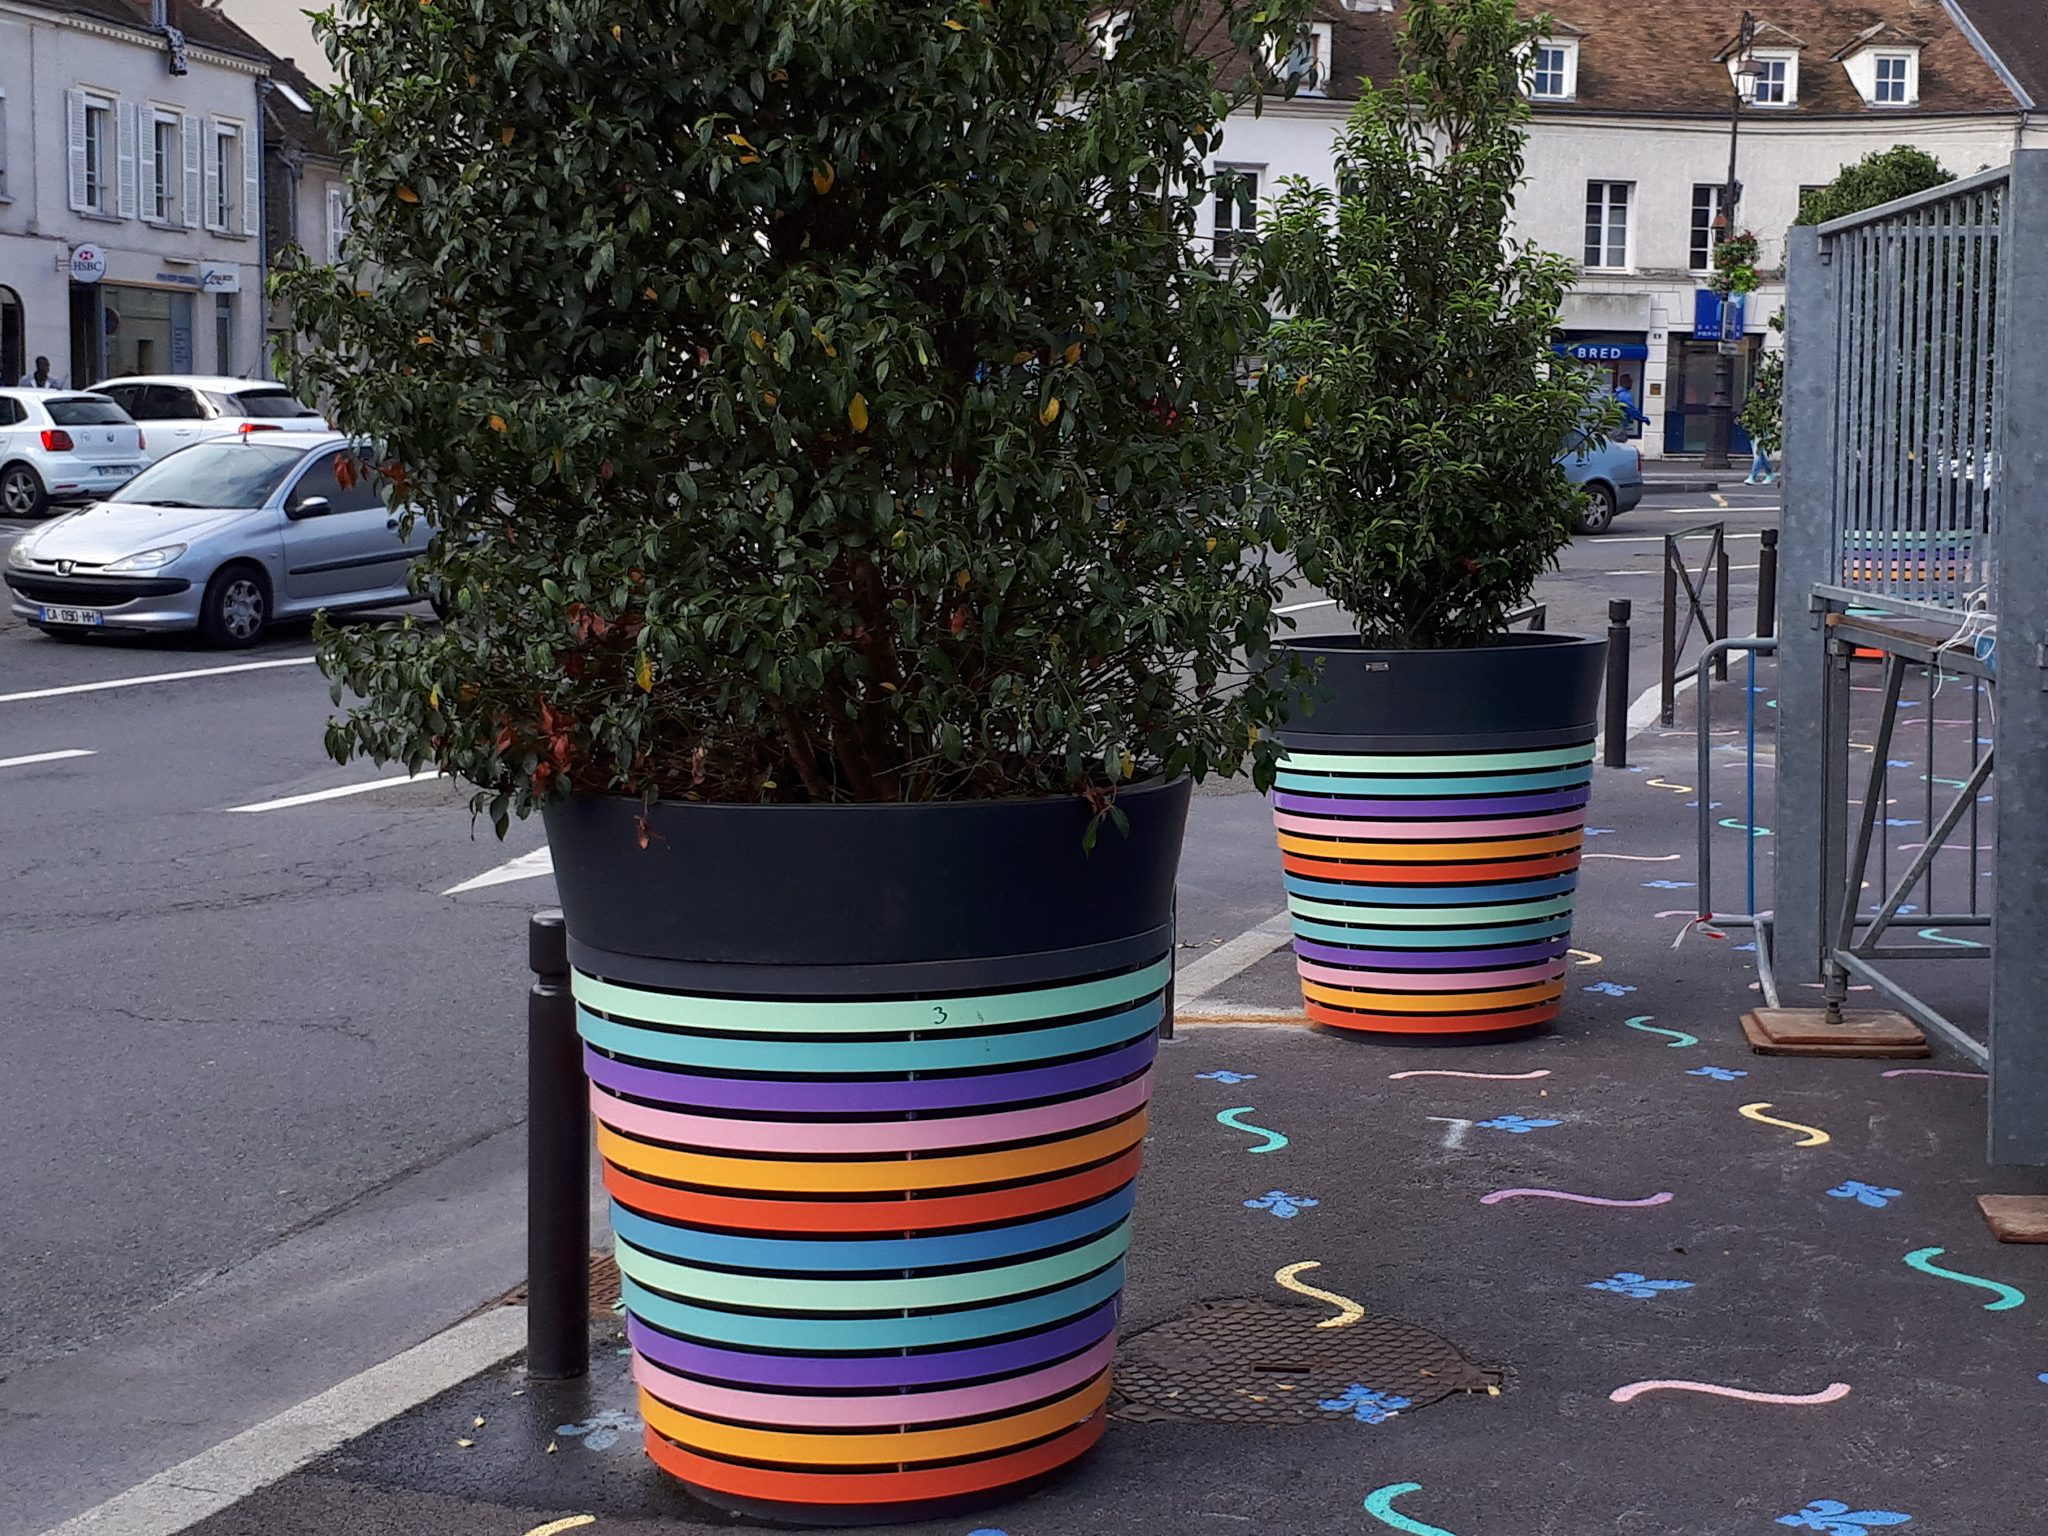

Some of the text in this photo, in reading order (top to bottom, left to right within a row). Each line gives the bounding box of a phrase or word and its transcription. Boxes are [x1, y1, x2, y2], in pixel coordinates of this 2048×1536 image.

[74, 261, 102, 271] HSBC
[1577, 347, 1622, 359] BRED
[932, 1005, 948, 1025] 3
